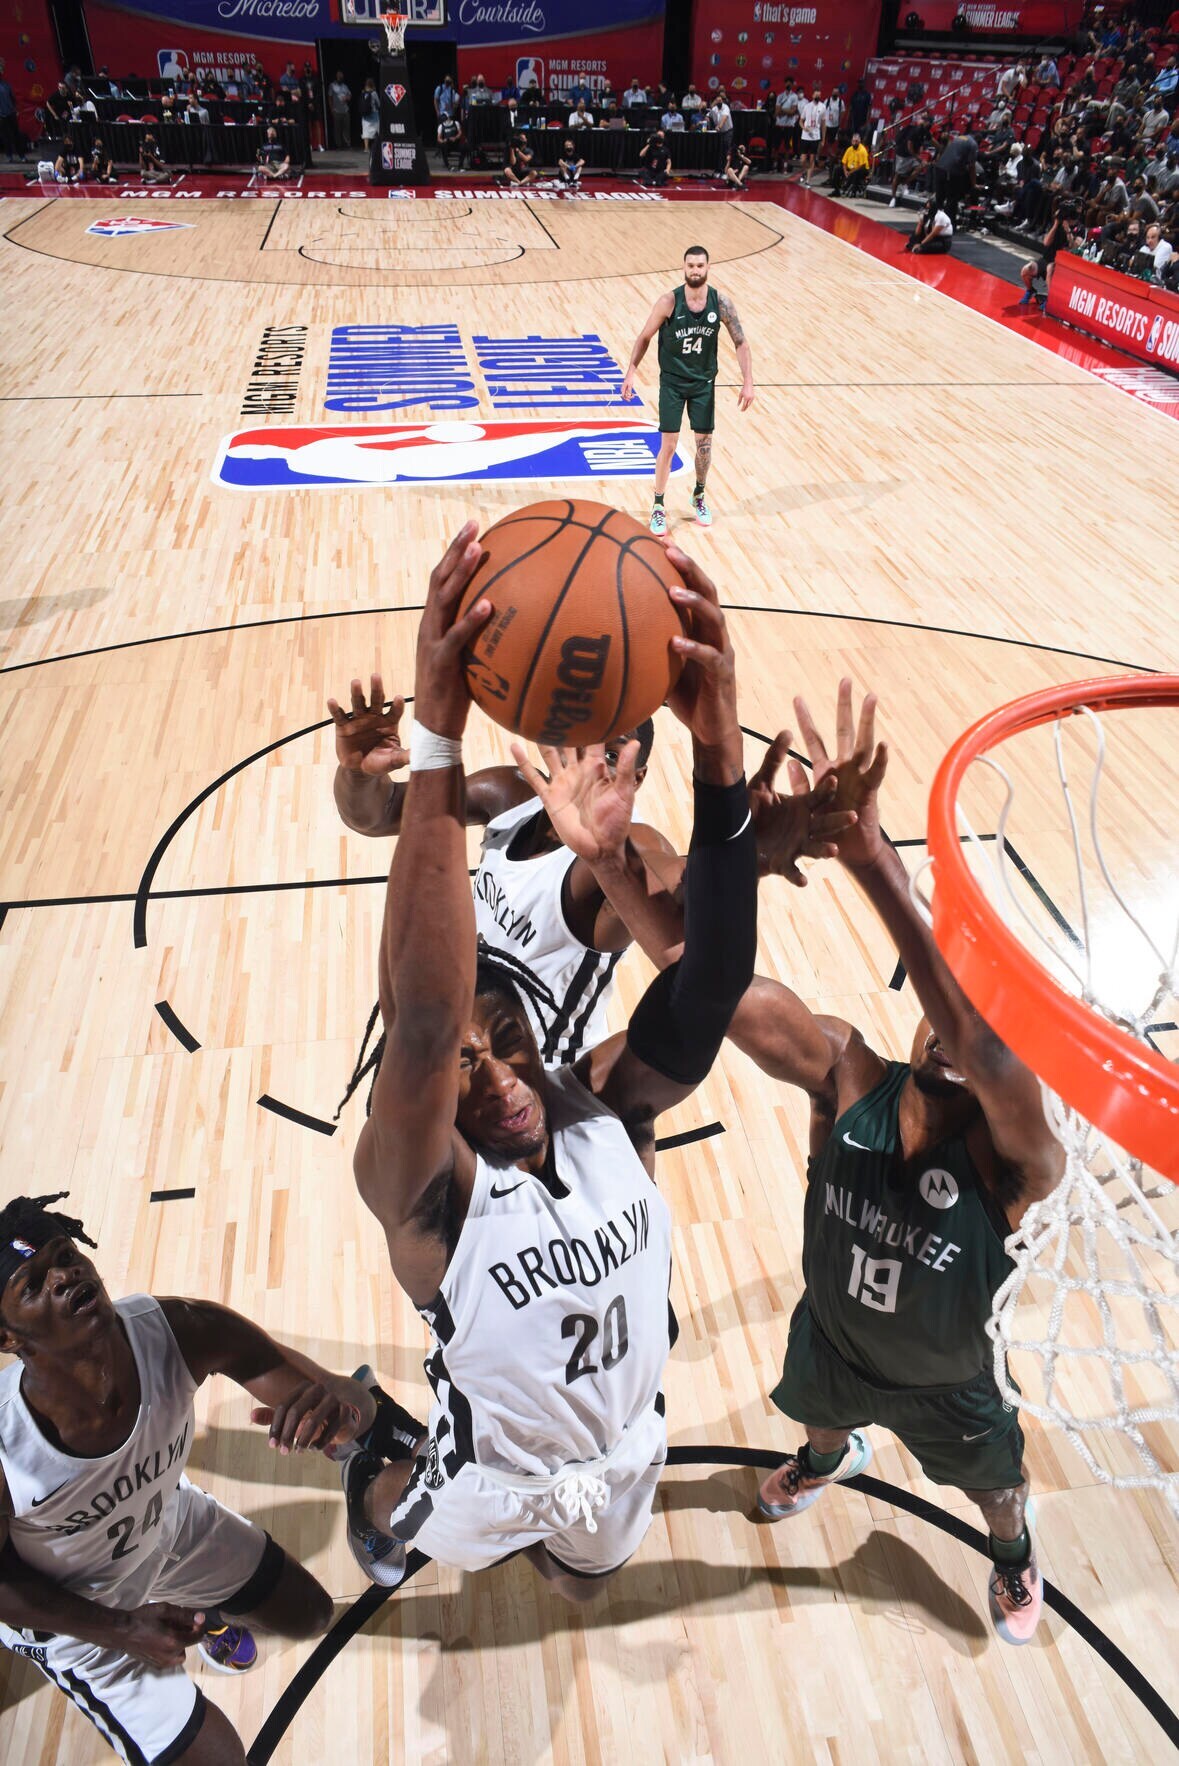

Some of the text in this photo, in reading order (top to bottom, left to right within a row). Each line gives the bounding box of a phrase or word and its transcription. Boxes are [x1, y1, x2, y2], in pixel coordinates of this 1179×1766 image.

[217, 0, 319, 18] Michelob
[459, 0, 546, 32] Courtside
[762, 3, 817, 27] that's game
[193, 52, 256, 65] MGM RESORTS
[549, 59, 607, 71] MGM RESORTS
[120, 189, 669, 201] MGM RESORTS SUMMER LEAGUE
[1068, 286, 1097, 318] MGM
[1095, 297, 1148, 342] RESORTS
[240, 326, 309, 415] MGM RESORTS
[323, 323, 480, 412] SUMMER
[472, 334, 645, 409] LEAGUE
[682, 337, 703, 354] 54
[578, 438, 656, 471] NBA
[487, 1198, 649, 1311] BROOKLYN
[824, 1181, 962, 1272] MILWAUKEE
[847, 1243, 903, 1313] 19
[560, 1294, 629, 1386] 20
[106, 1489, 163, 1561] 24
